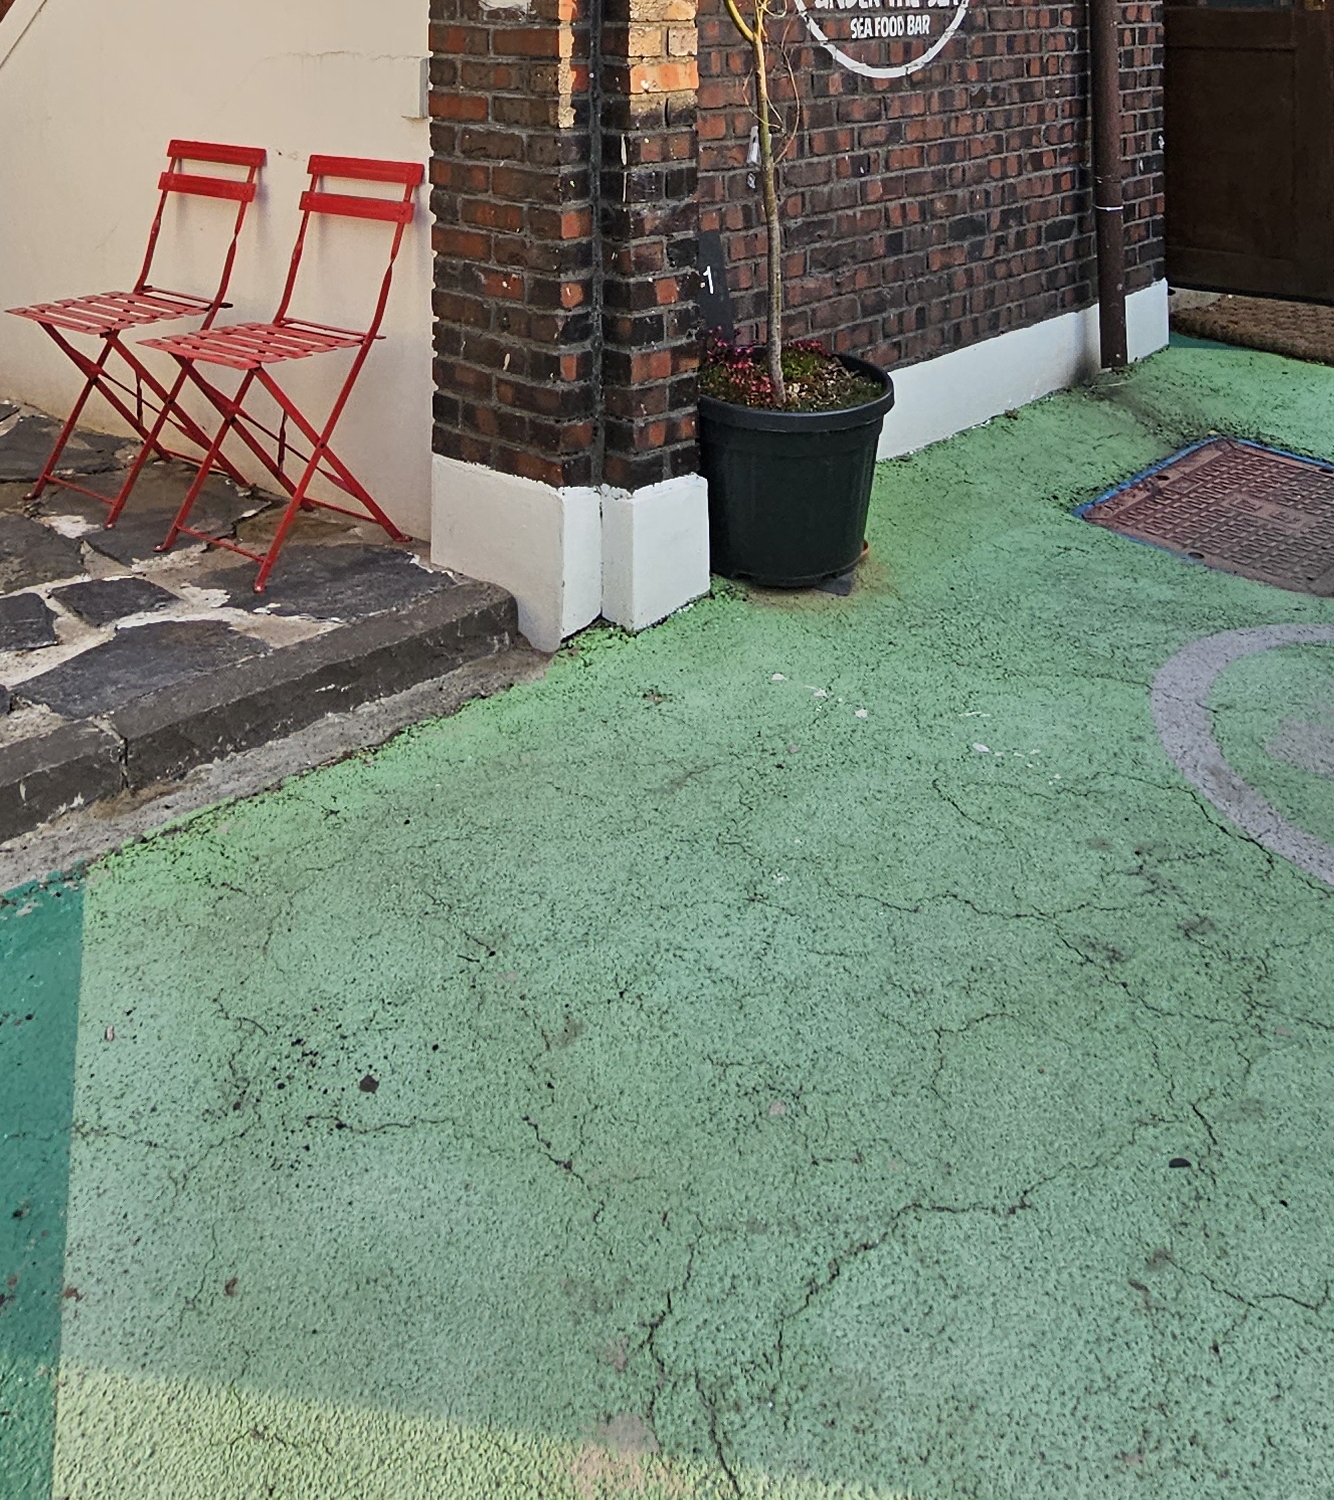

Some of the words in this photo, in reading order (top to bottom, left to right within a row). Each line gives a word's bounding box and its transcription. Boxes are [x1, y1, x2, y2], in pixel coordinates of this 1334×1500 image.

[850, 17, 873, 39] SEA
[875, 15, 904, 38] FOOD
[906, 13, 930, 36] BAR
